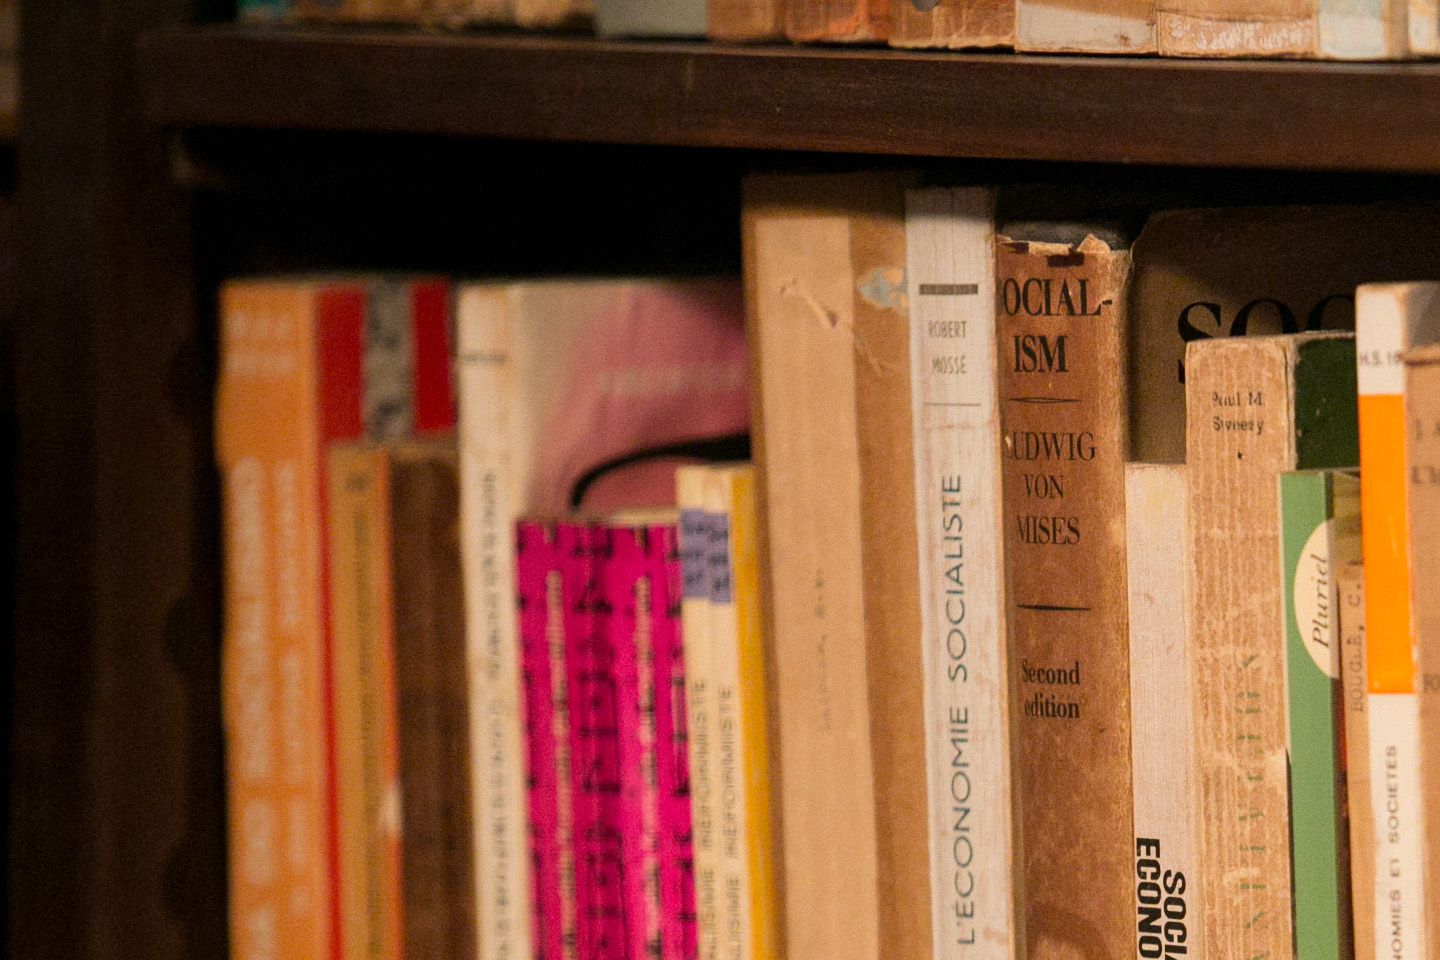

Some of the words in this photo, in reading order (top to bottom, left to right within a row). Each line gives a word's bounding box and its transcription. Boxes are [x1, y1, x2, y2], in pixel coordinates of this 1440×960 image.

[1001, 277, 1113, 316] OCIAL-
[928, 321, 967, 338] ROBERT
[1012, 335, 1069, 373] ISM
[1024, 474, 1065, 498] VON
[1015, 516, 1080, 545] MISES
[941, 474, 969, 683] SOCIALISTE
[1310, 554, 1330, 649] Pluriel
[1020, 659, 1081, 686] Second
[1023, 694, 1081, 719] edition
[1385, 744, 1401, 843] SOCIETES
[949, 706, 976, 946] L'ÉCONOMIE
[1389, 857, 1401, 878] ET
